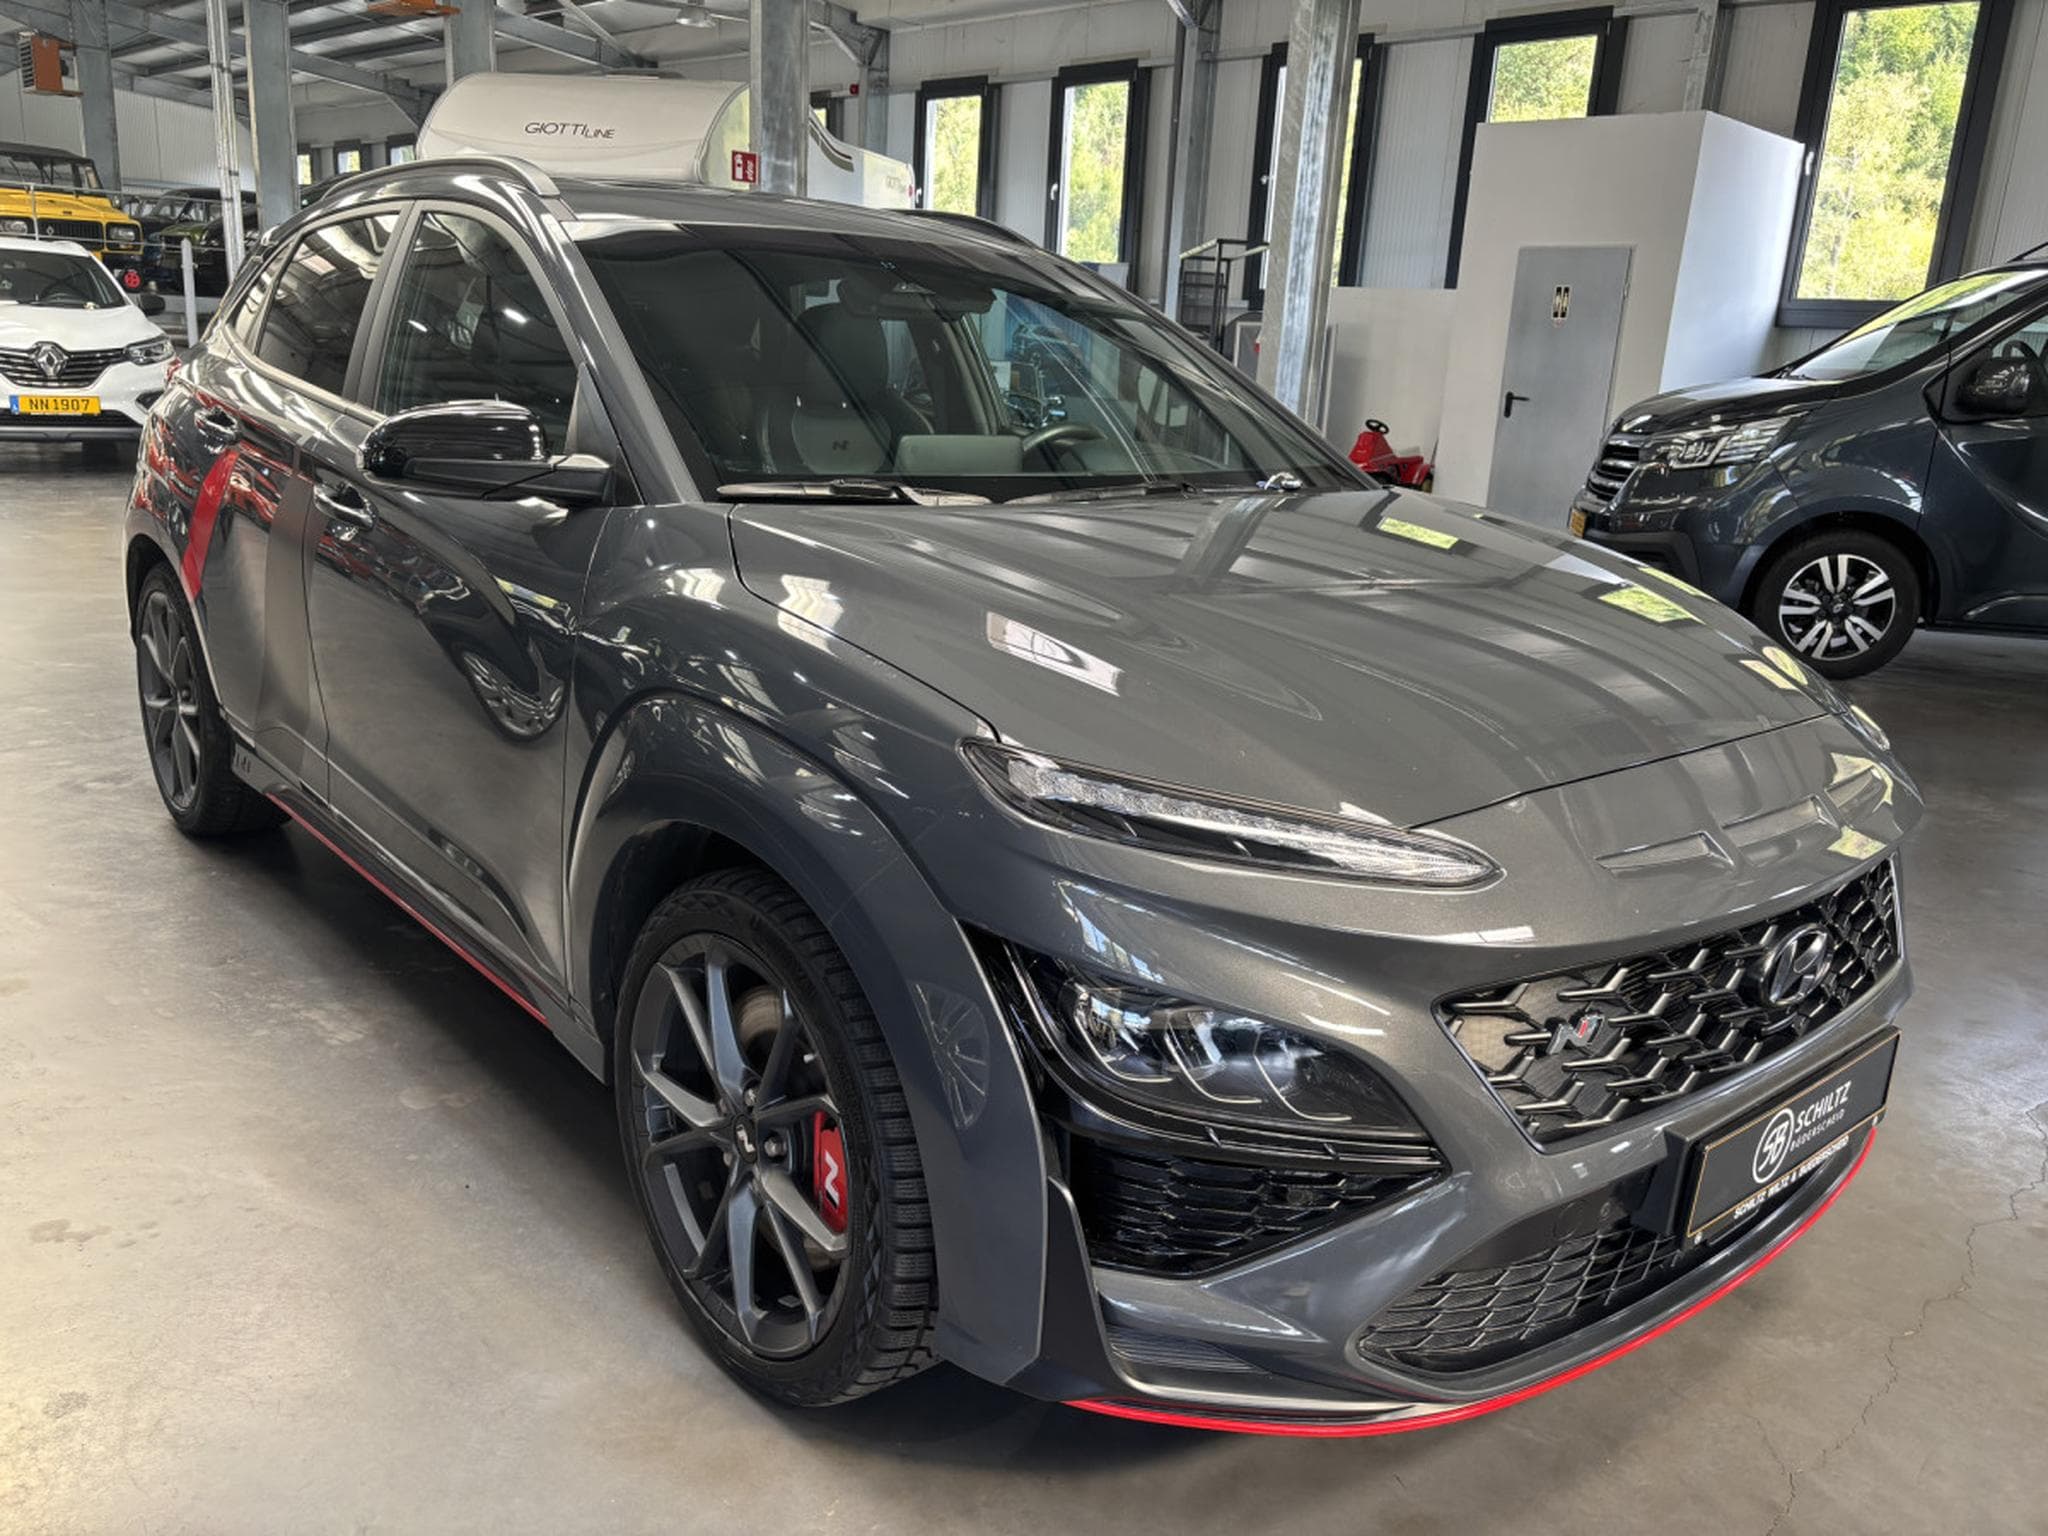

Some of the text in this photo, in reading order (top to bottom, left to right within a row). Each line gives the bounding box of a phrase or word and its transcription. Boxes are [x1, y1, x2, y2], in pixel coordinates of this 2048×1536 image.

[28, 398, 90, 411] NN 1907
[1795, 1080, 1852, 1133] SCHILTZ
